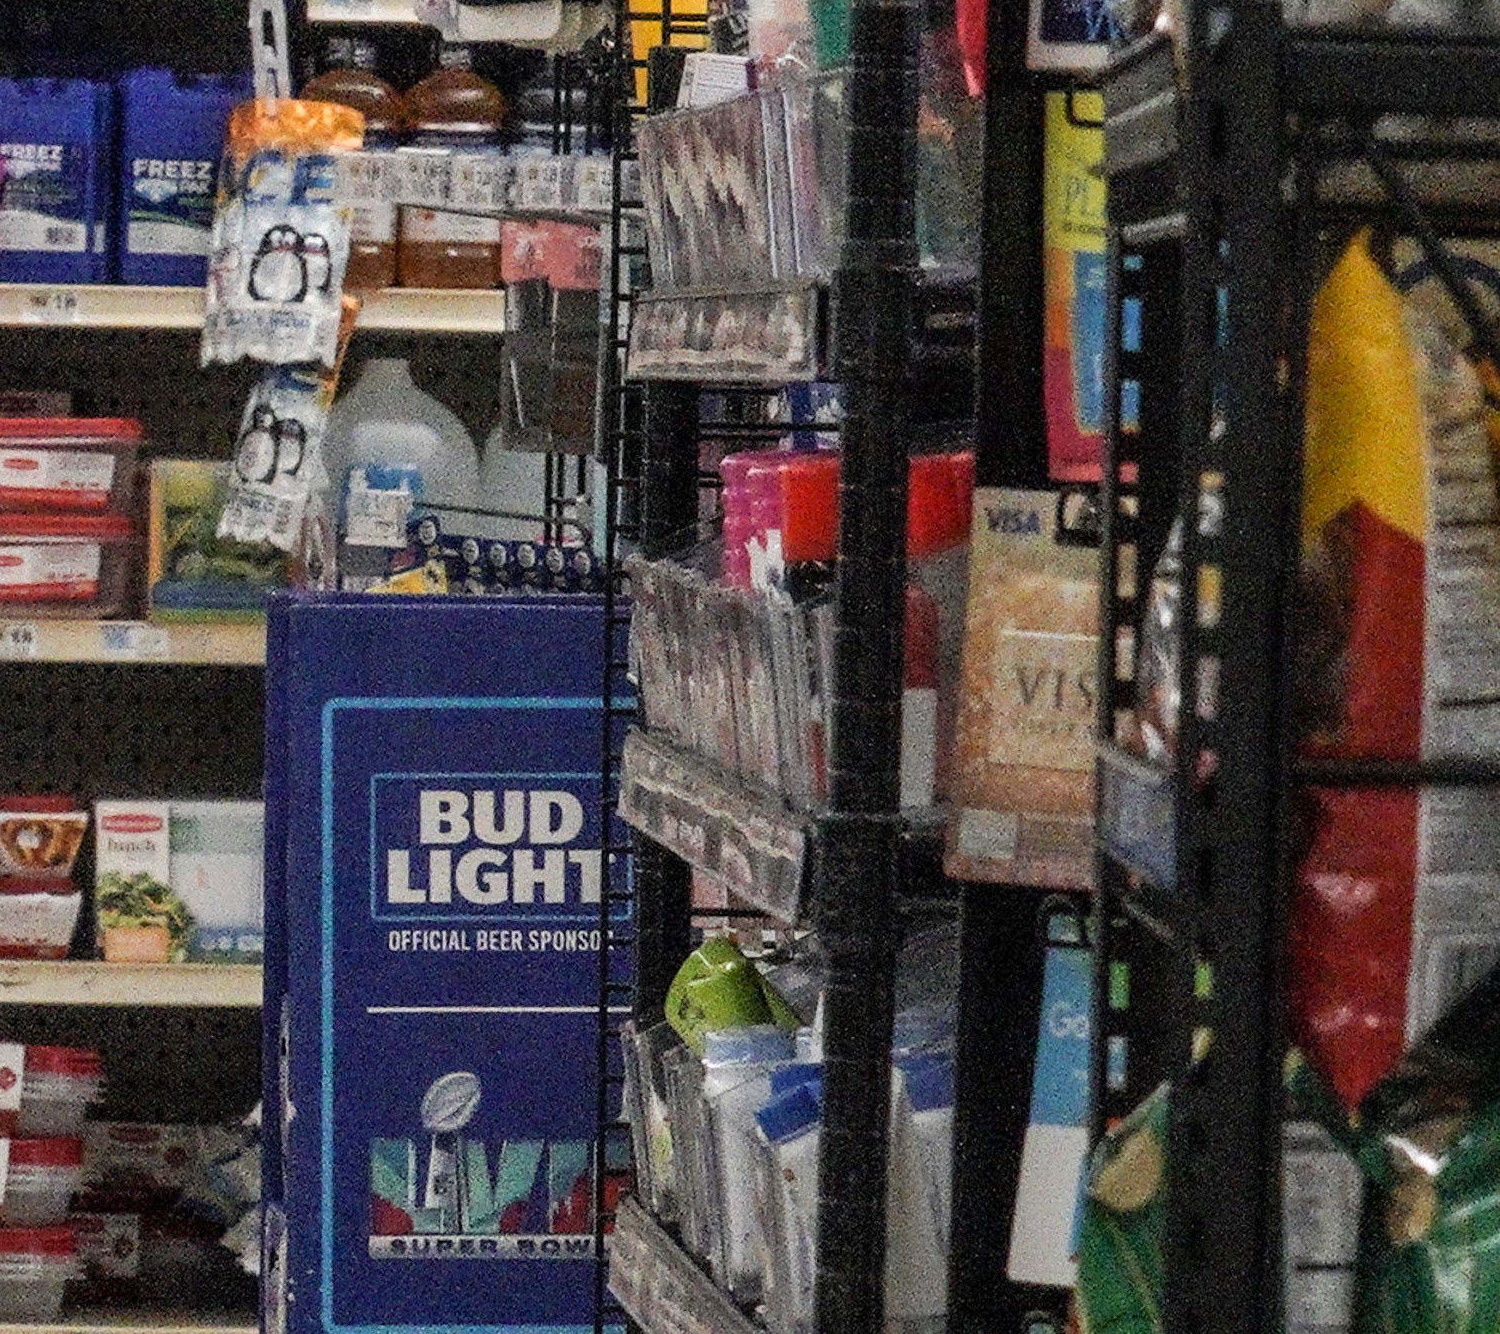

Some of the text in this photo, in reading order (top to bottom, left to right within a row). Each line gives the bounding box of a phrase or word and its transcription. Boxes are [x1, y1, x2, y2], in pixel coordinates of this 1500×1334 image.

[133, 159, 213, 179] FREEZ
[986, 507, 1041, 534] VISA
[1018, 667, 1097, 709] VIS
[419, 790, 584, 845] BUD
[386, 848, 616, 905] LIGHT
[388, 930, 471, 952] OFFICIAL
[476, 930, 524, 952] BEER
[390, 1237, 499, 1256] SUPER
